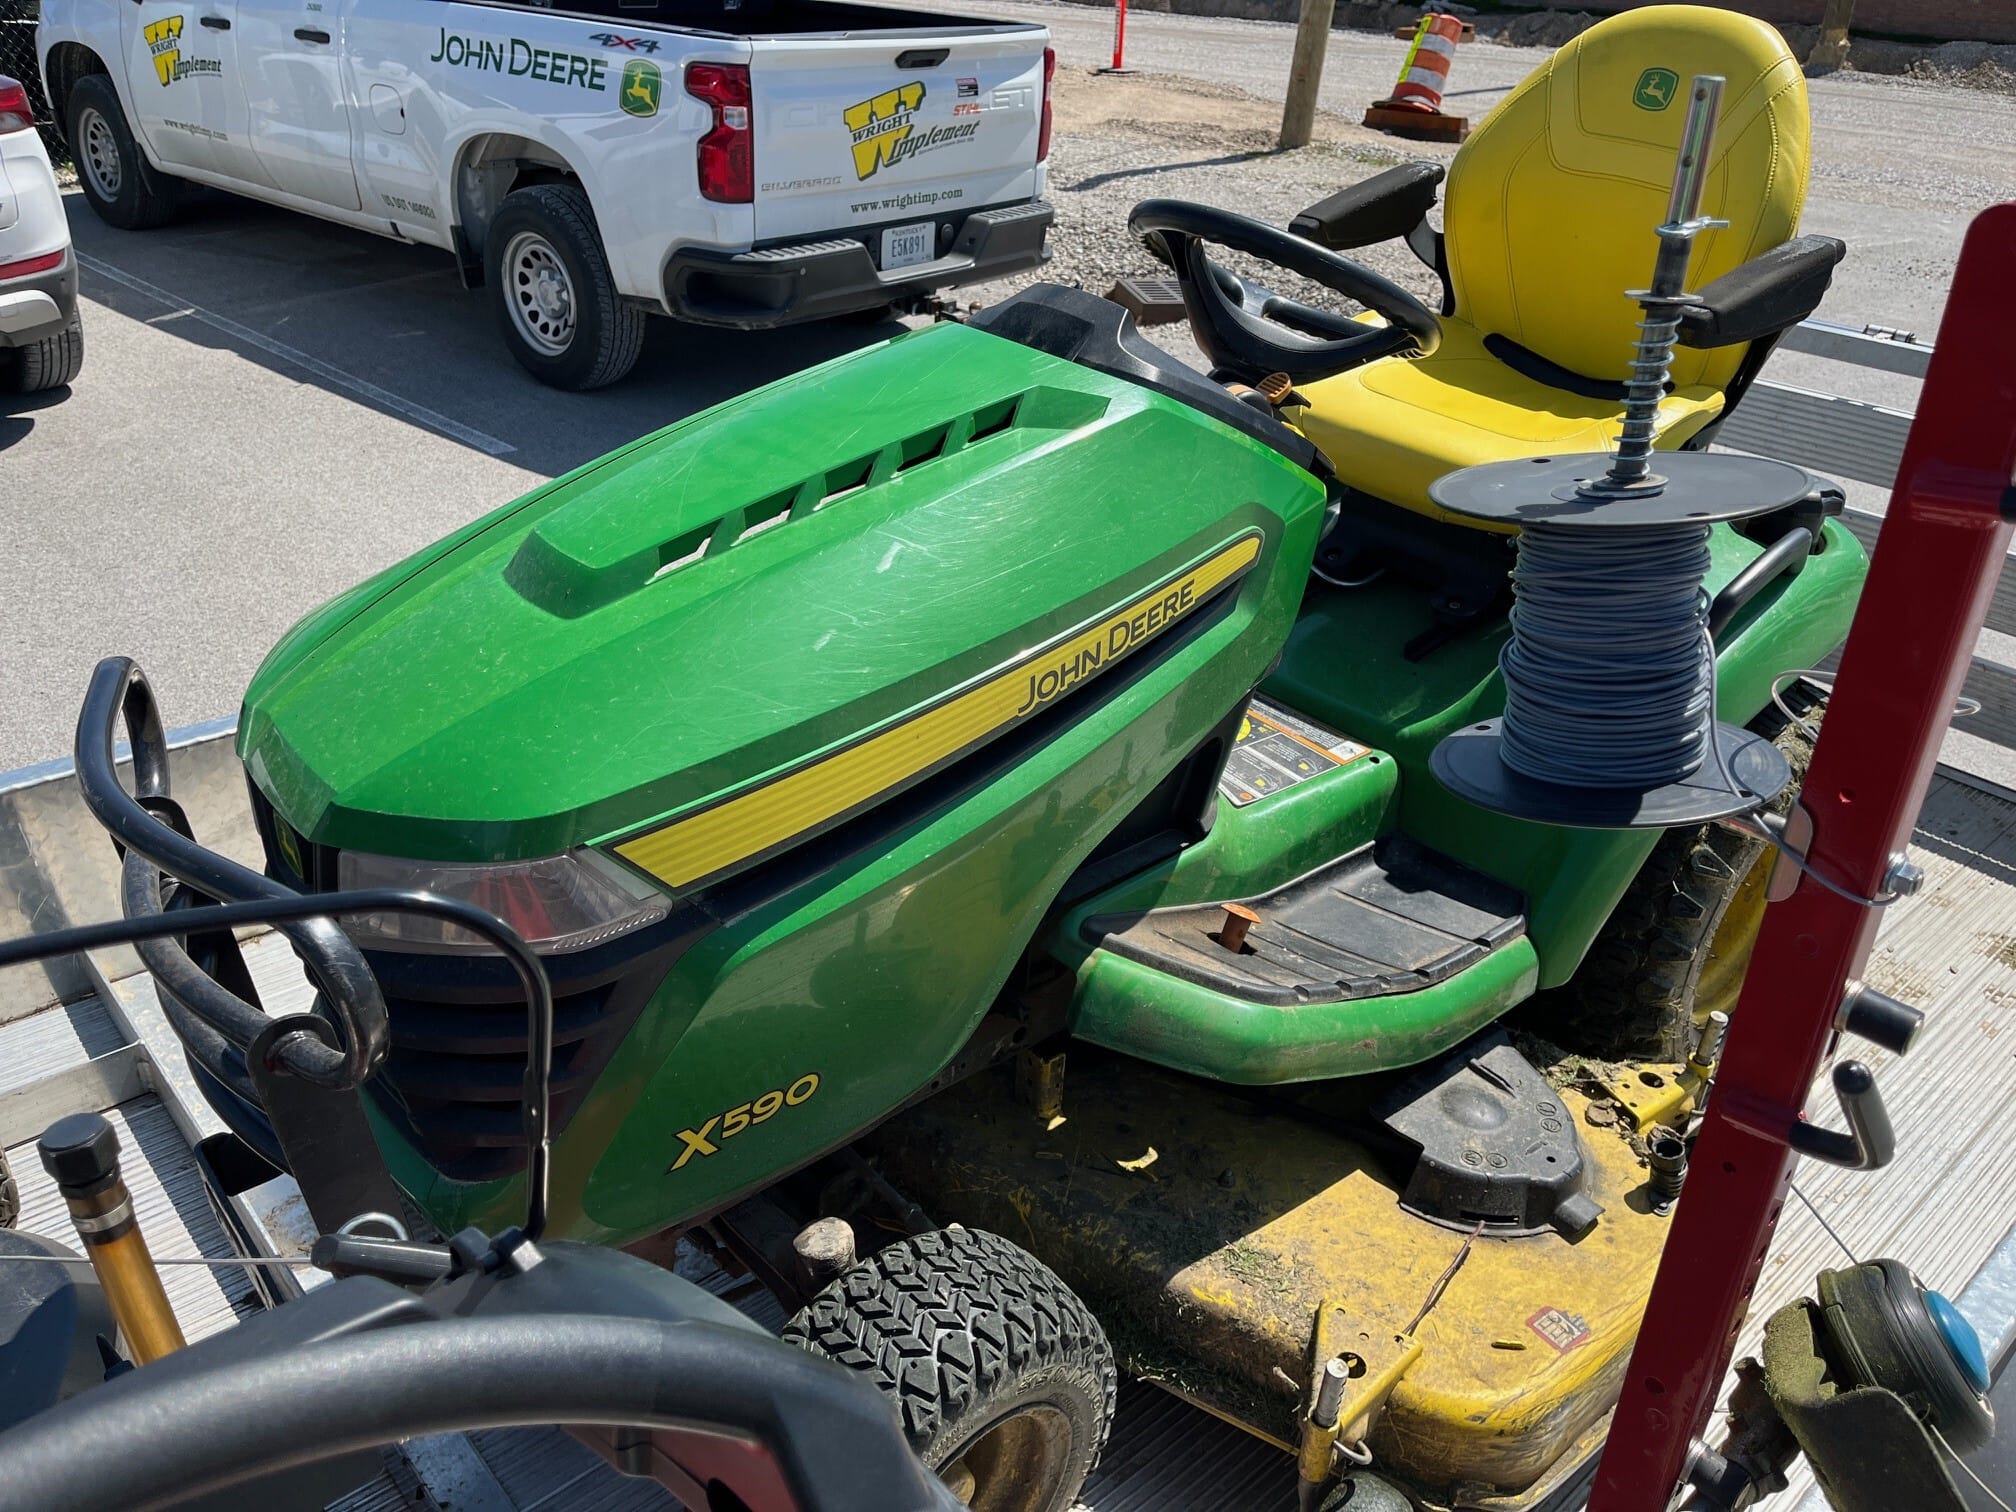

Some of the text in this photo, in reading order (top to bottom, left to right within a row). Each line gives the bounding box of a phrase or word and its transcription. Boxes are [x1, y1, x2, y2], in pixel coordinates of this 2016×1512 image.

[150, 38, 178, 54] WRIGHT
[430, 27, 609, 92] JOHN DEERE
[172, 55, 222, 81] Implement
[851, 111, 915, 143] WRIGHT
[887, 120, 981, 164] Implement
[850, 187, 963, 213] www.wrightimp.com
[891, 235, 925, 258] E5K891
[1018, 579, 1196, 714] JOHN DEERE
[666, 1072, 820, 1174] X590
